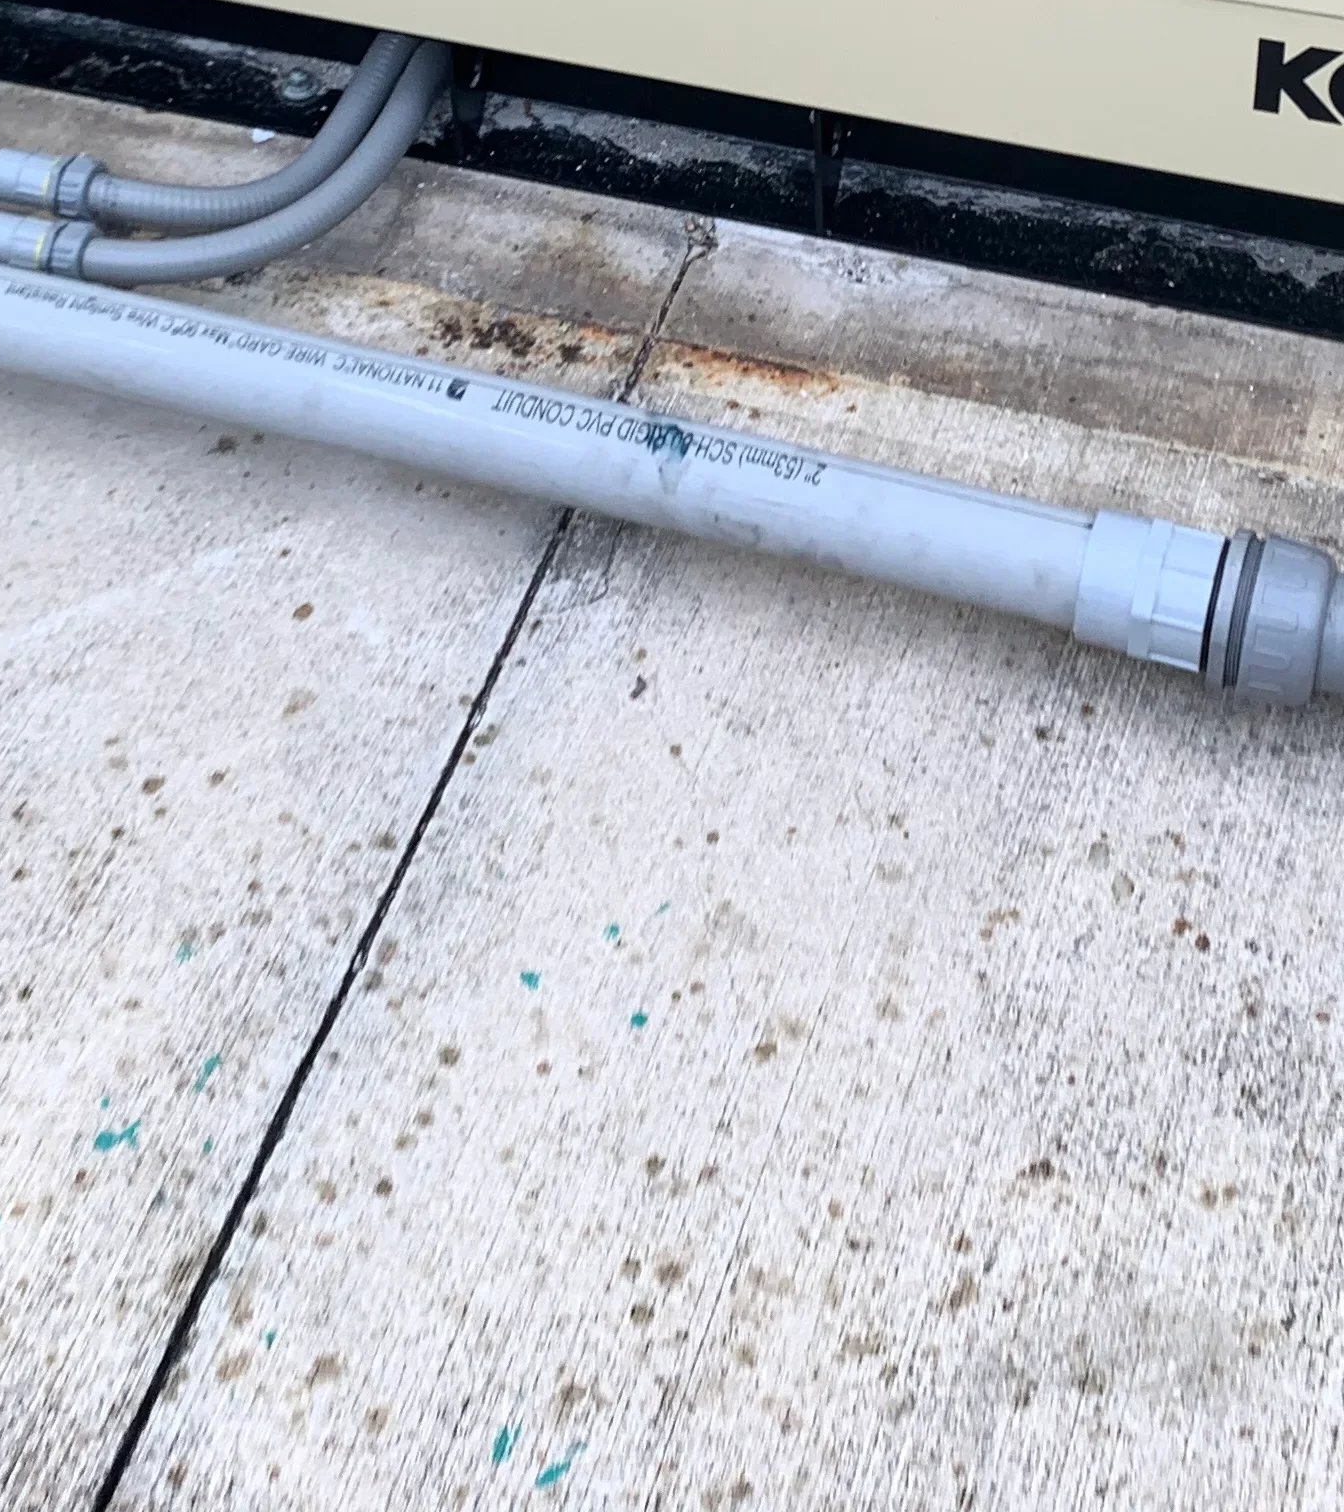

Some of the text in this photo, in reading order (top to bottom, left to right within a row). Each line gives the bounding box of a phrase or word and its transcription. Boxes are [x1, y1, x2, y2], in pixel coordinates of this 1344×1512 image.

[490, 389, 576, 427] CONDUIT
[576, 407, 617, 437] PVC
[617, 417, 669, 455] RIGID
[738, 444, 804, 480] (53mm)
